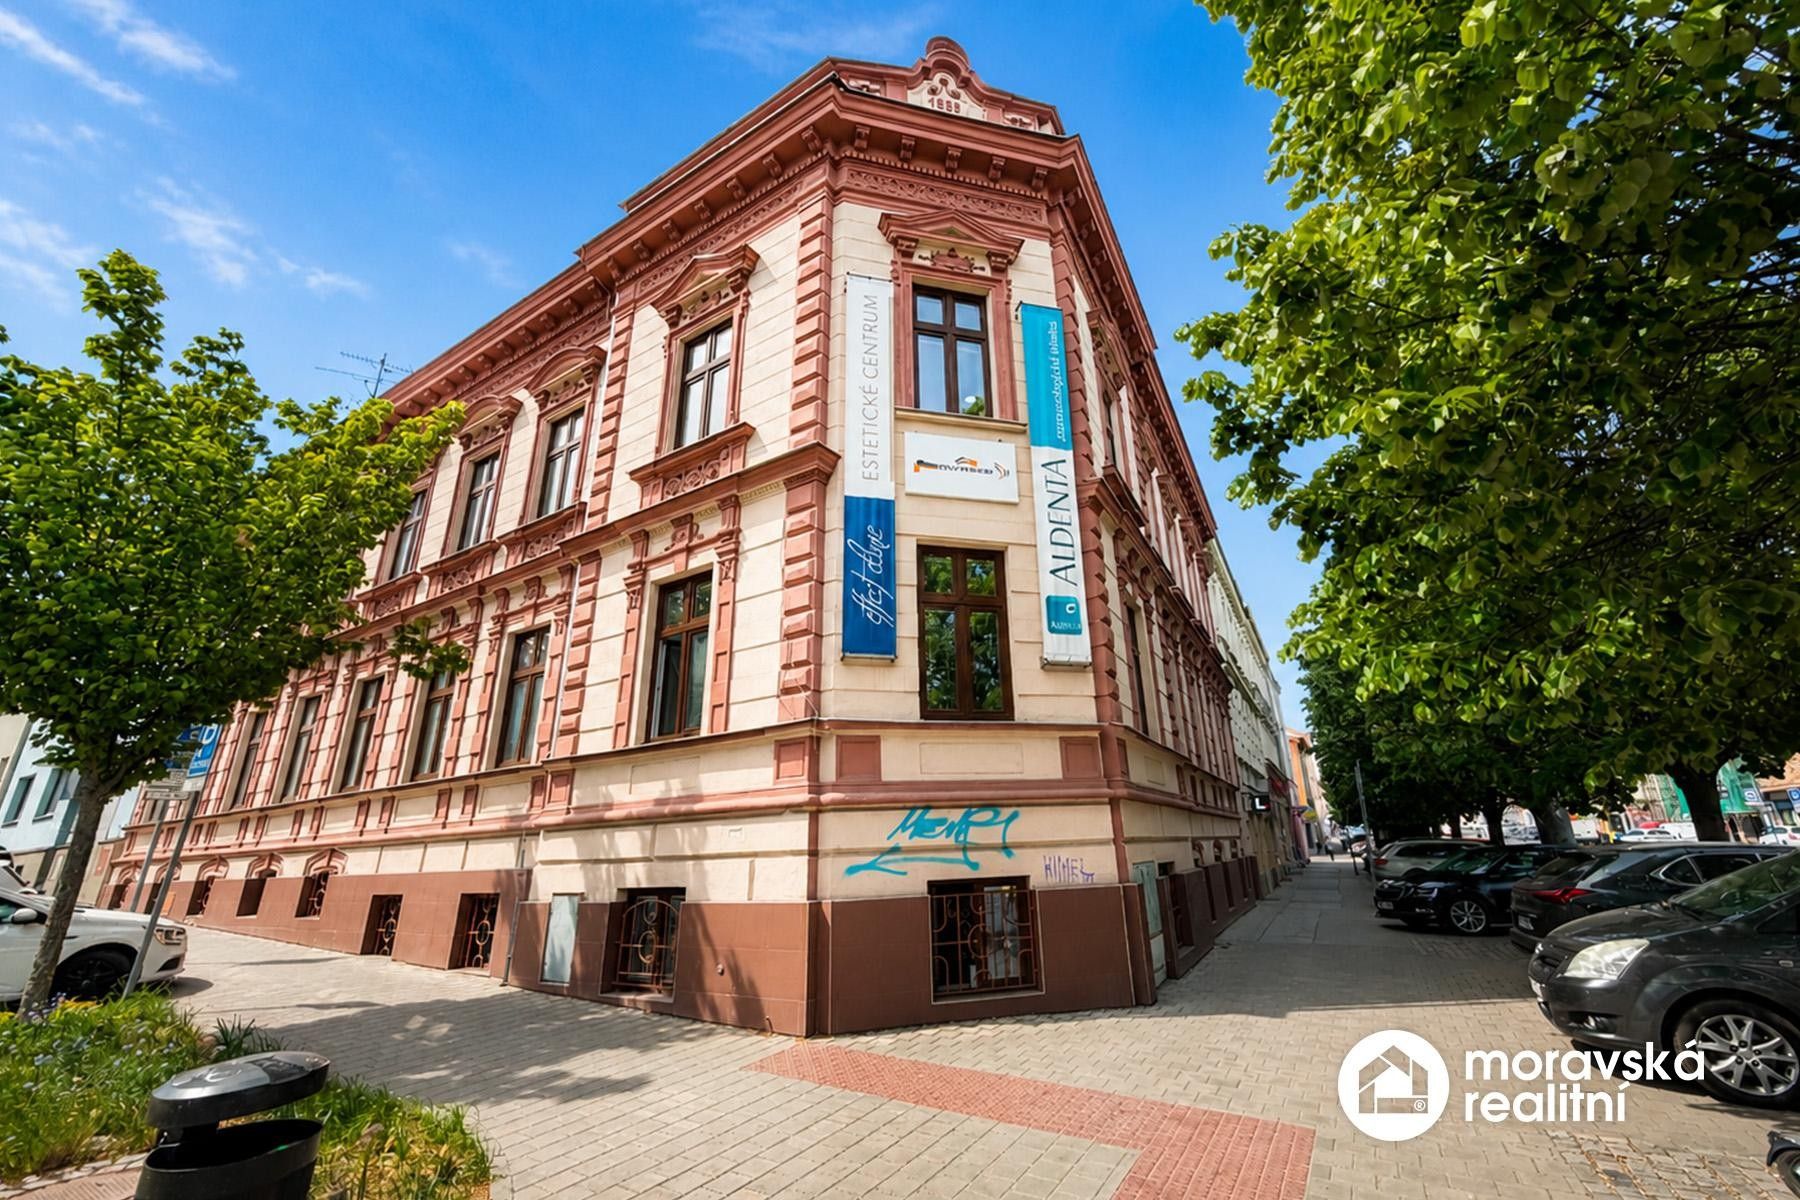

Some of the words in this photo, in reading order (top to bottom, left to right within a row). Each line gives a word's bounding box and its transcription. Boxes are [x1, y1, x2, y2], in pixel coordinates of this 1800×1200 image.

[862, 295, 878, 380] CENTRUM
[858, 384, 879, 481] ESTETICKÉ
[1041, 459, 1078, 587] ALDENTA
